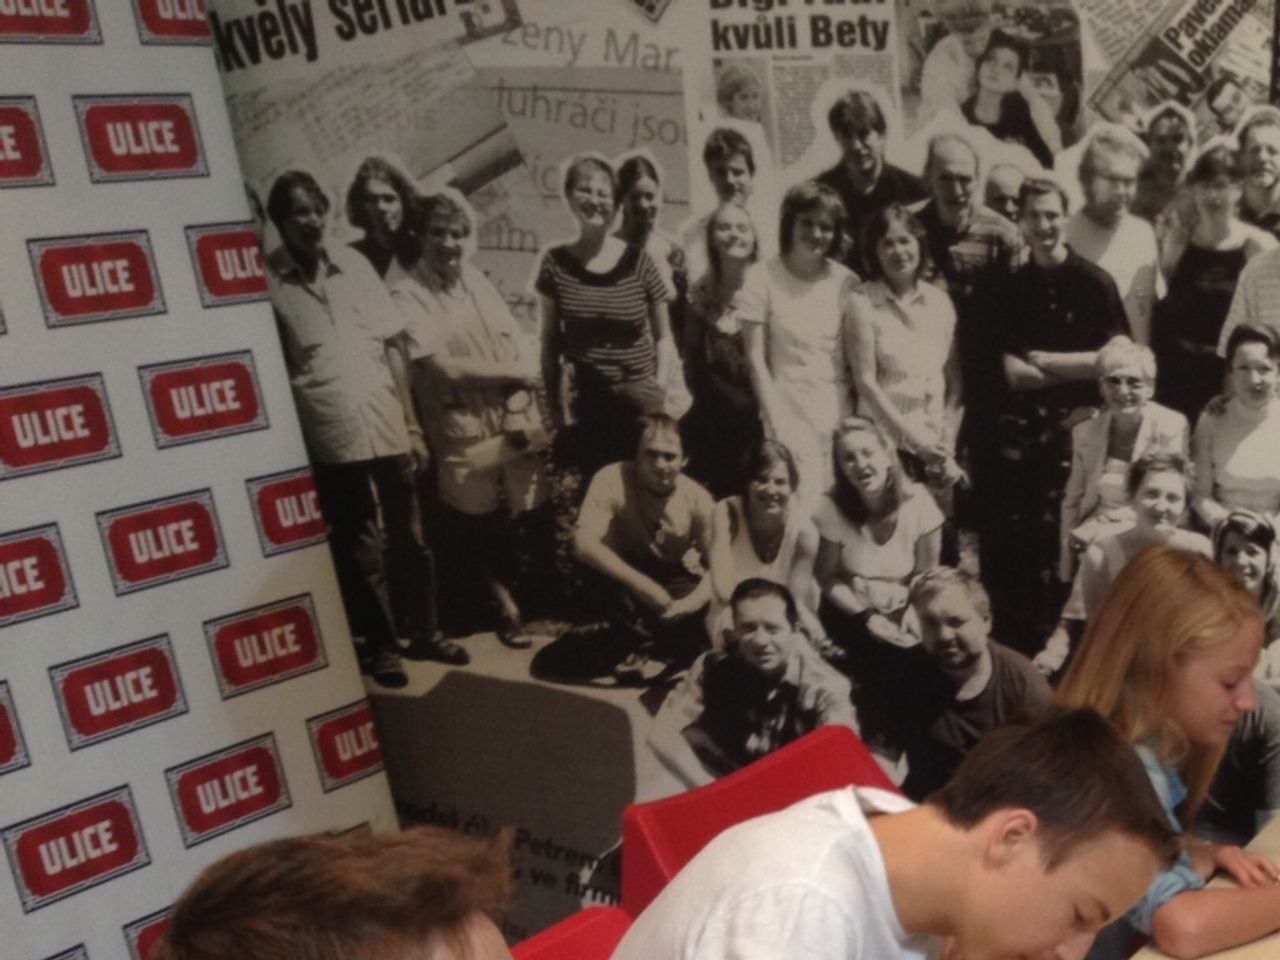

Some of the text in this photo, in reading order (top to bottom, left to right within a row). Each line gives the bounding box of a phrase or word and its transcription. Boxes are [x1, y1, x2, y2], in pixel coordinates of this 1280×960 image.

[711, 14, 890, 52] kvůli Bety
[105, 120, 180, 157] ULICE
[61, 258, 135, 299] ULICE
[170, 378, 241, 420] ULICE
[12, 403, 90, 448] ULICE
[129, 519, 199, 564] ULICE
[233, 621, 302, 667] ULICE
[83, 666, 159, 717] ULICE
[196, 764, 265, 814] ULICE
[39, 819, 119, 876] ULICE
